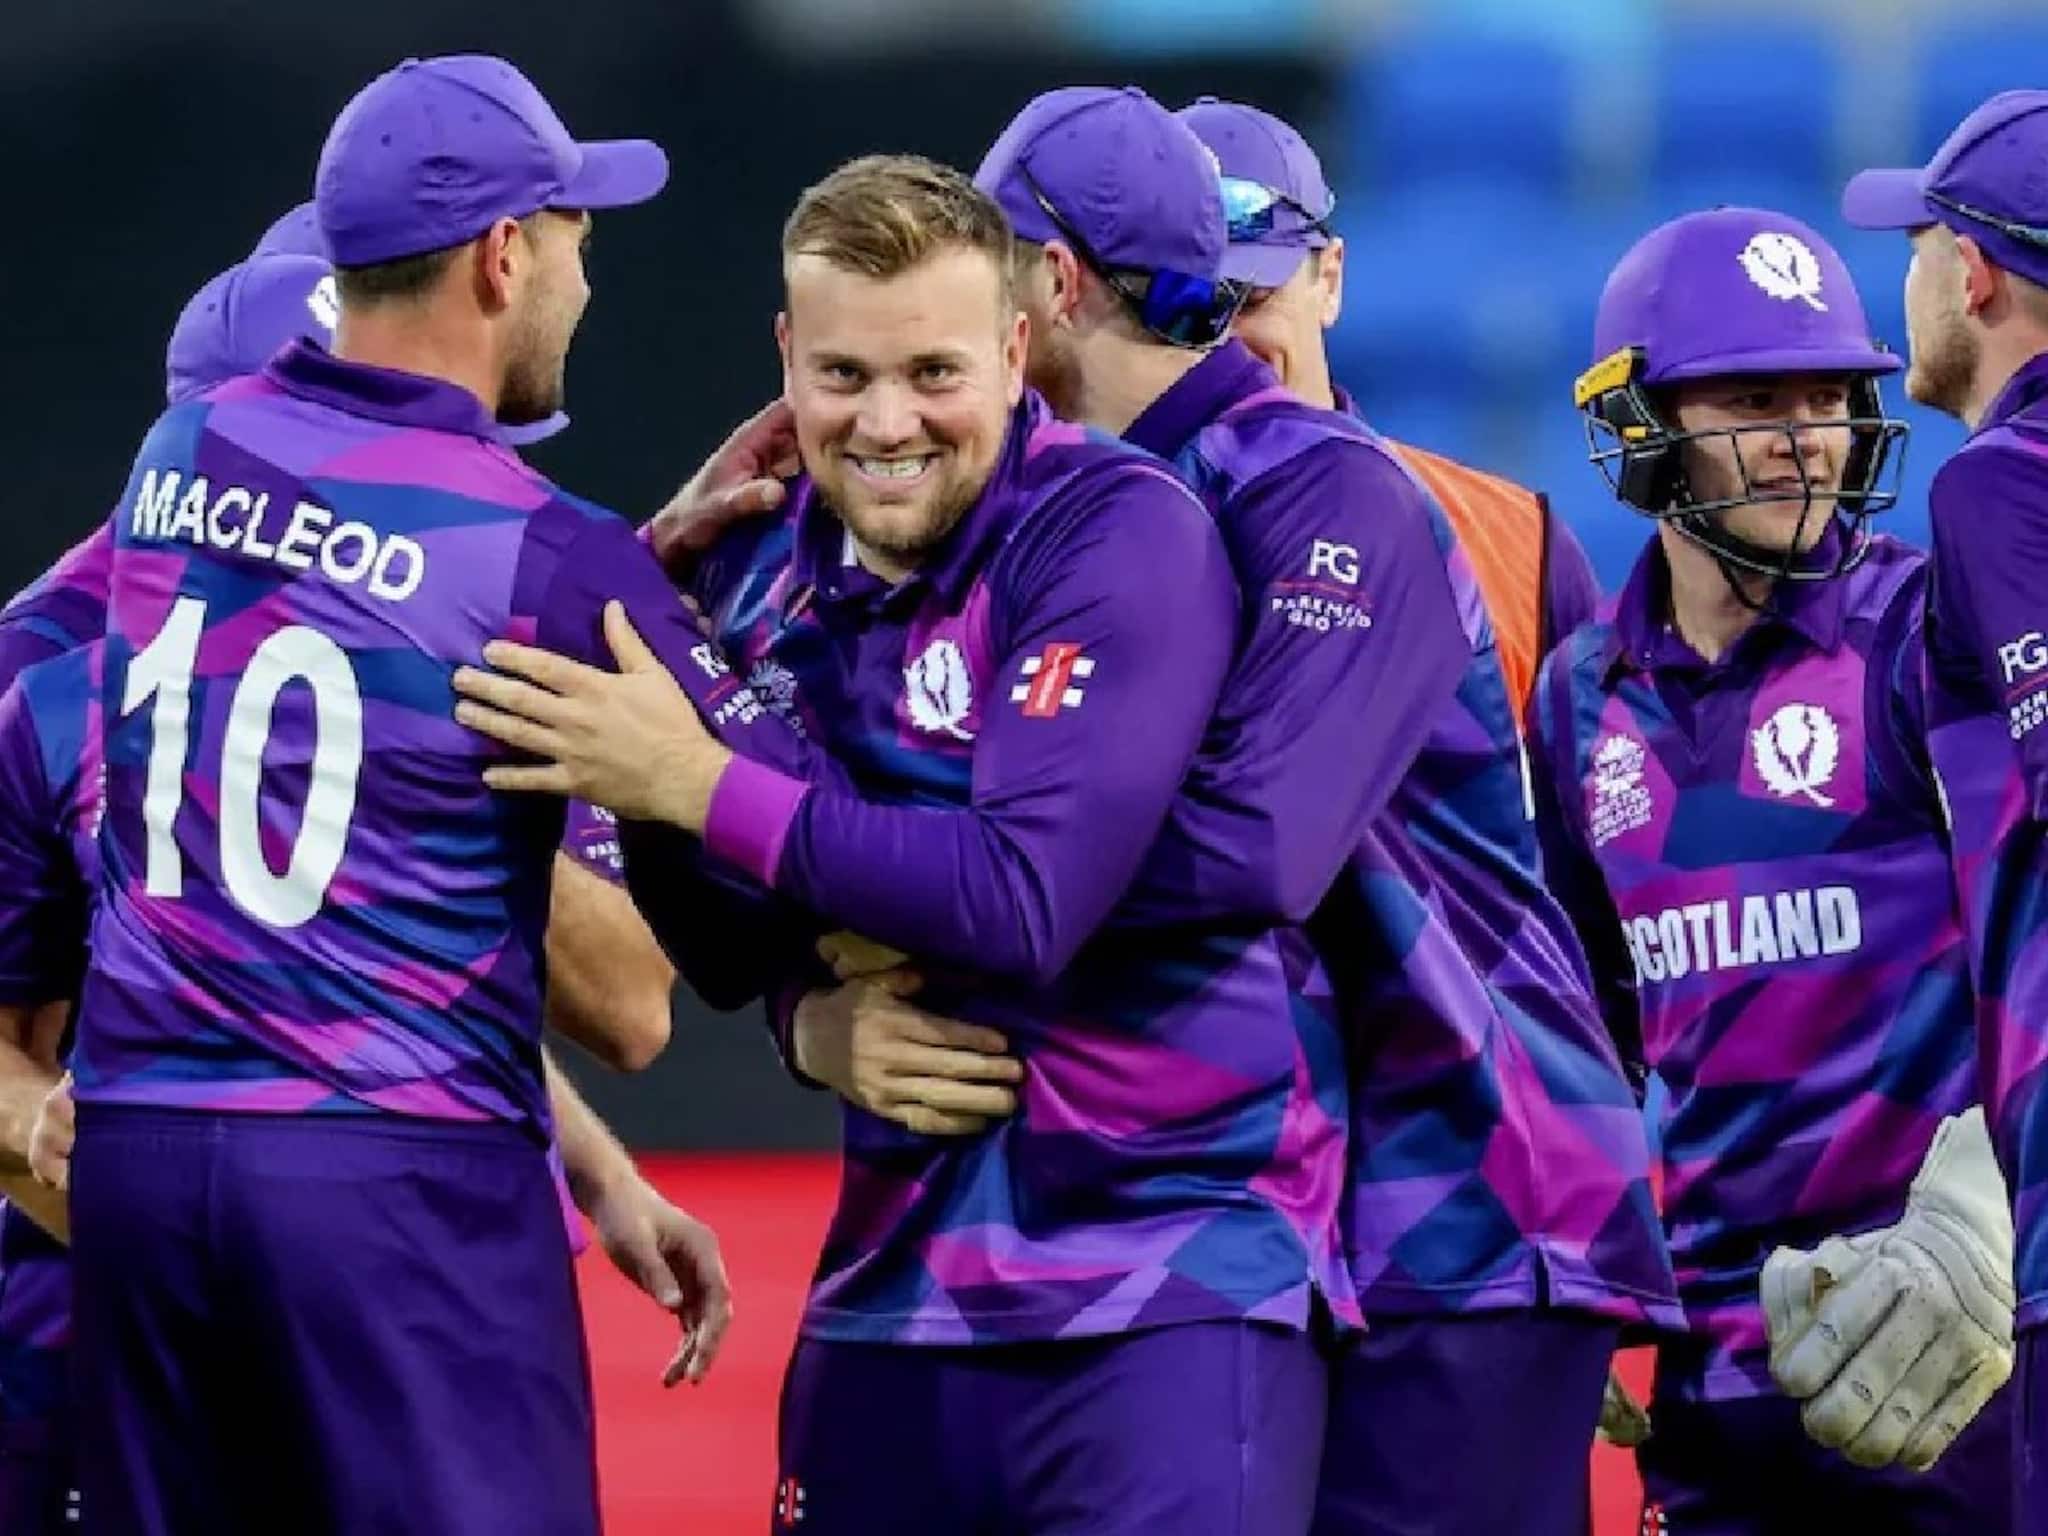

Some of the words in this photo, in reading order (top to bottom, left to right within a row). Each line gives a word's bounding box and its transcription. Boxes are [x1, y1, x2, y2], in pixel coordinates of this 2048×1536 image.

[131, 469, 425, 601] MACLEOD
[1307, 538, 1359, 585] PG
[120, 594, 363, 929] 10
